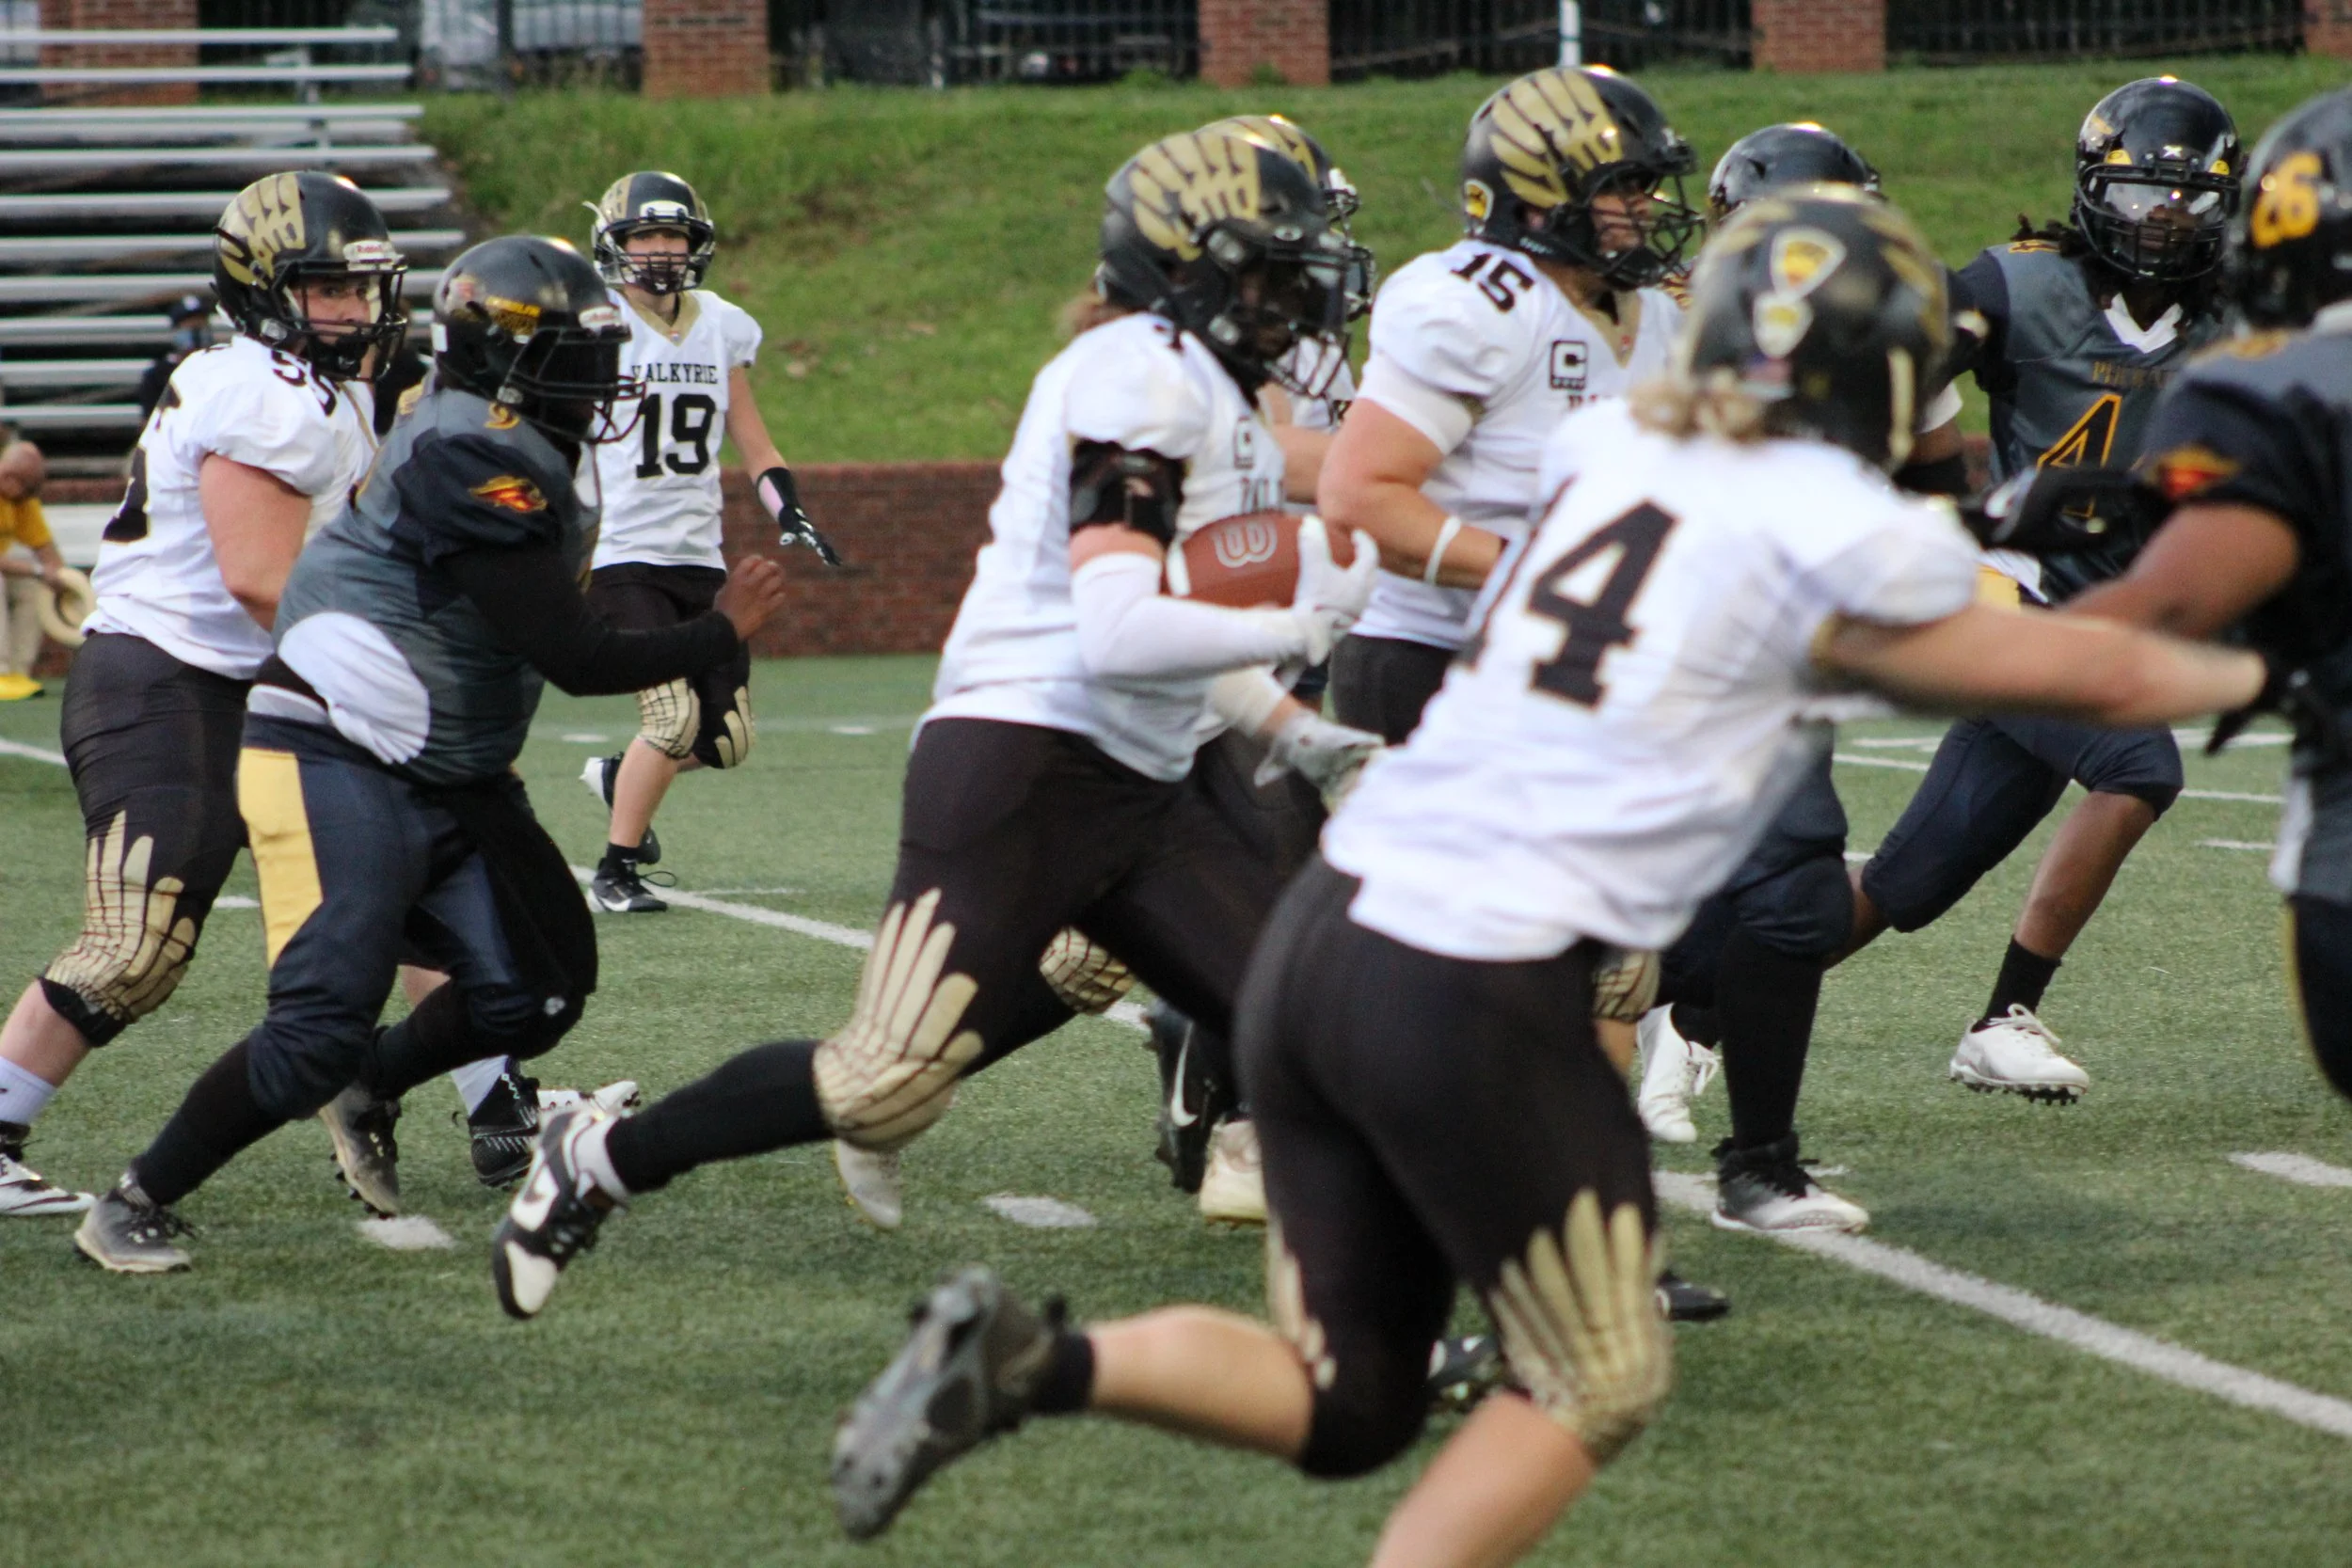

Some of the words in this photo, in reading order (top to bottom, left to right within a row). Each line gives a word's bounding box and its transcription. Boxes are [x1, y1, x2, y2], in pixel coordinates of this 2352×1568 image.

[1450, 252, 1535, 313] 15
[631, 362, 719, 385] VALKYRIE
[636, 392, 717, 480] 19
